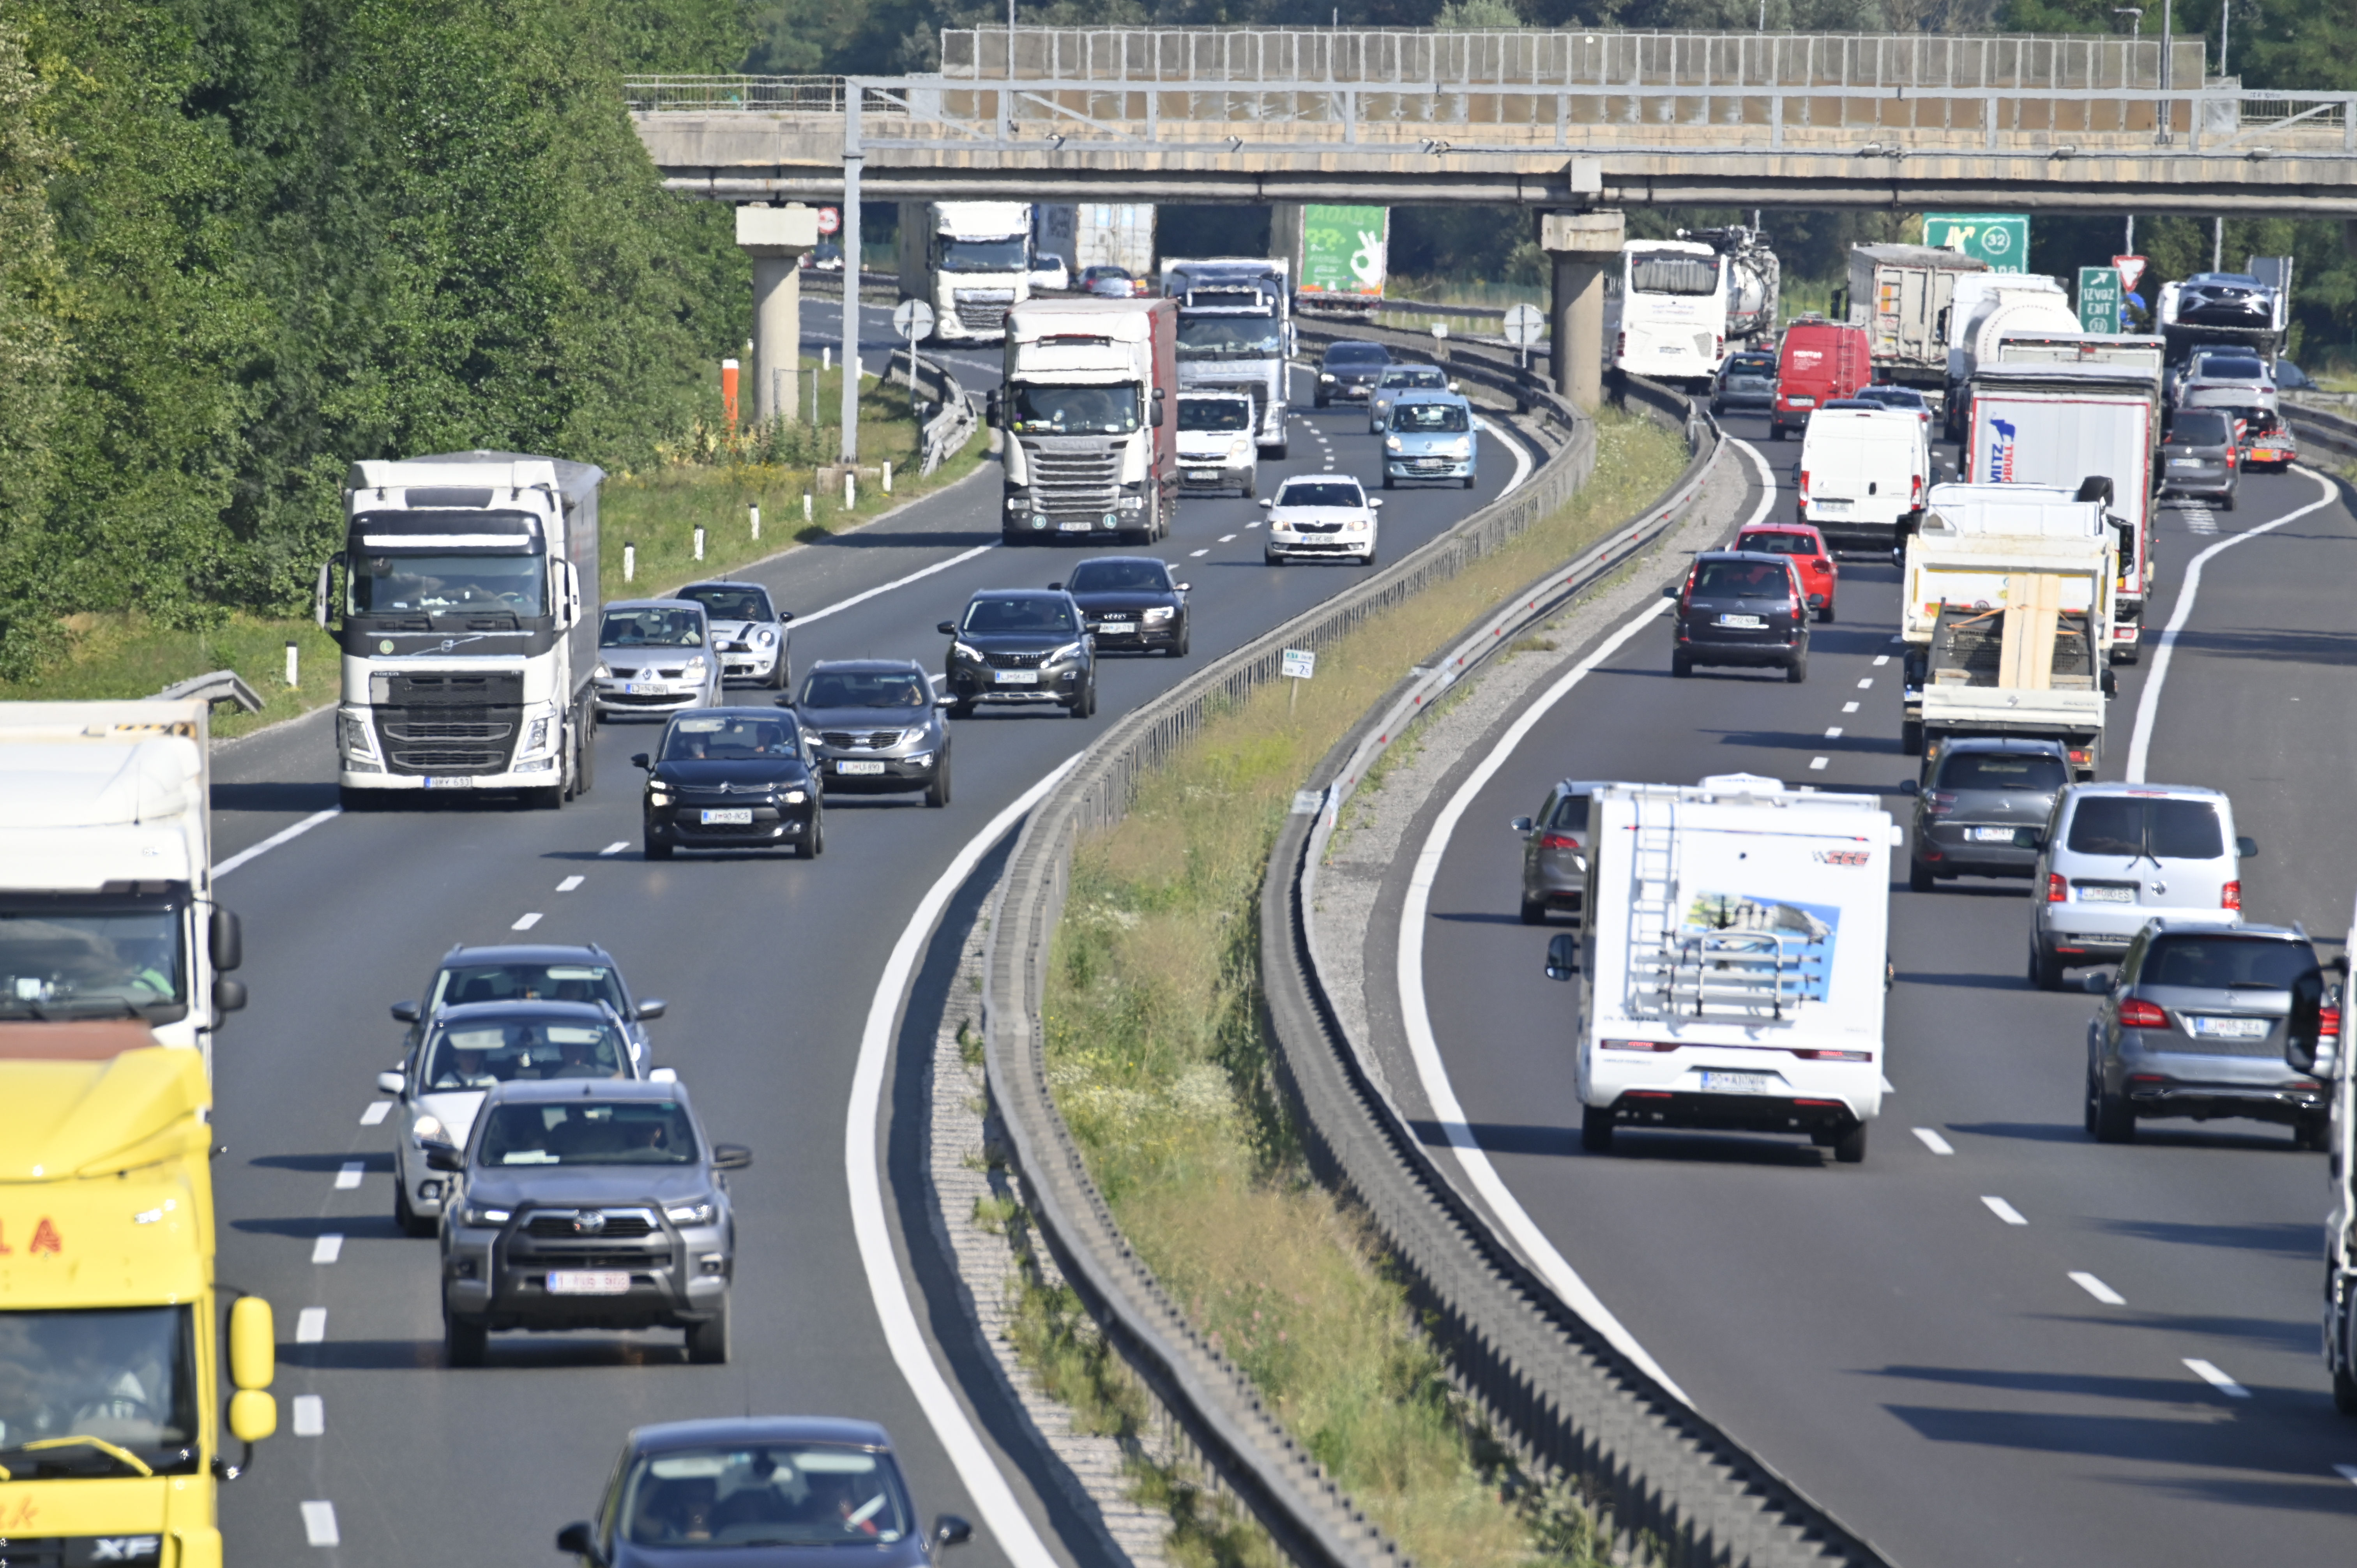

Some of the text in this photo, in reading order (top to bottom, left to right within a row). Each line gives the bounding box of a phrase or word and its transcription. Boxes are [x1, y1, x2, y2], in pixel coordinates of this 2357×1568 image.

[1988, 234, 2005, 246] 32
[2083, 288, 2115, 300] IZVOZ
[2087, 303, 2111, 314] EXIT
[1047, 440, 1098, 449] SCANIA
[93, 1537, 159, 1560] XF
